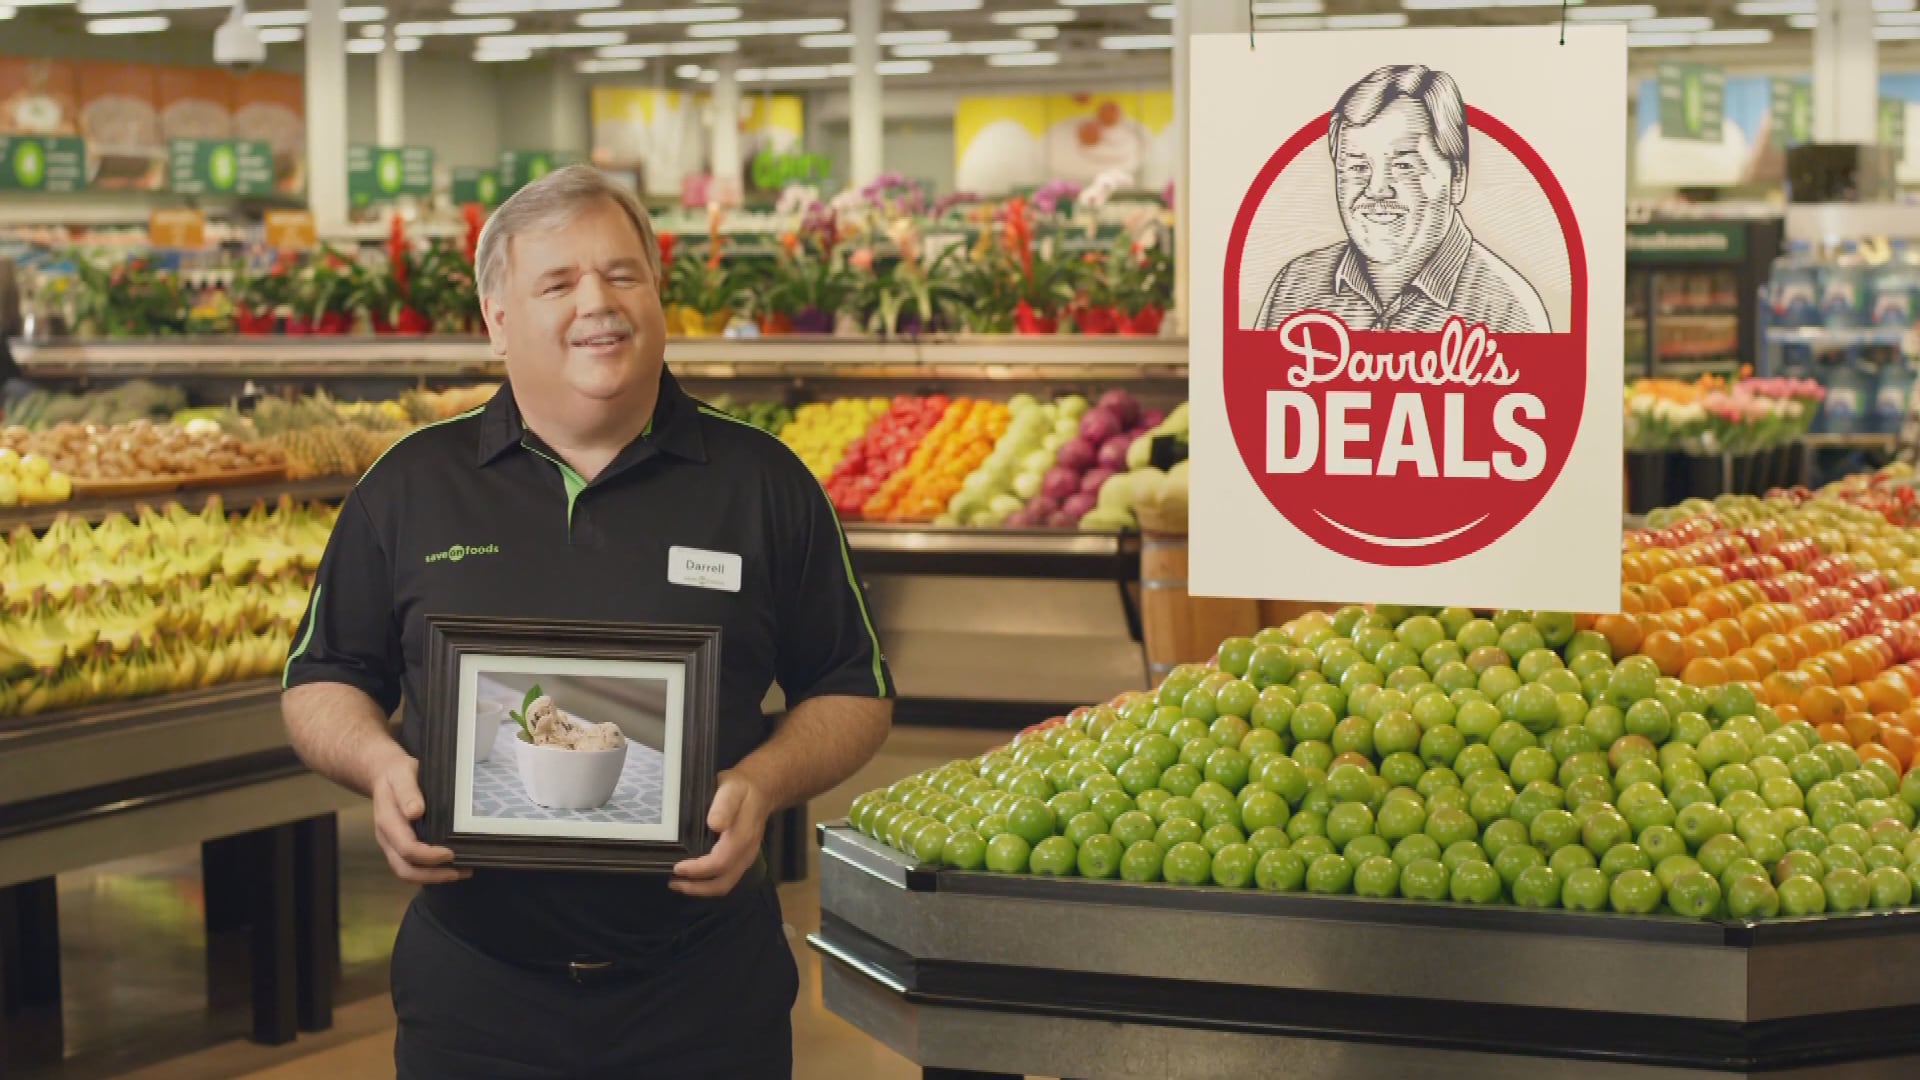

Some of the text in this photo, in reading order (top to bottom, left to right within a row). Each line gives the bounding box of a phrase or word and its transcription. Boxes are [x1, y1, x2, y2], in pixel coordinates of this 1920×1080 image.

[1280, 314, 1520, 388] Darrell's
[1267, 390, 1547, 481] DEALS
[686, 559, 725, 574] Darrell
